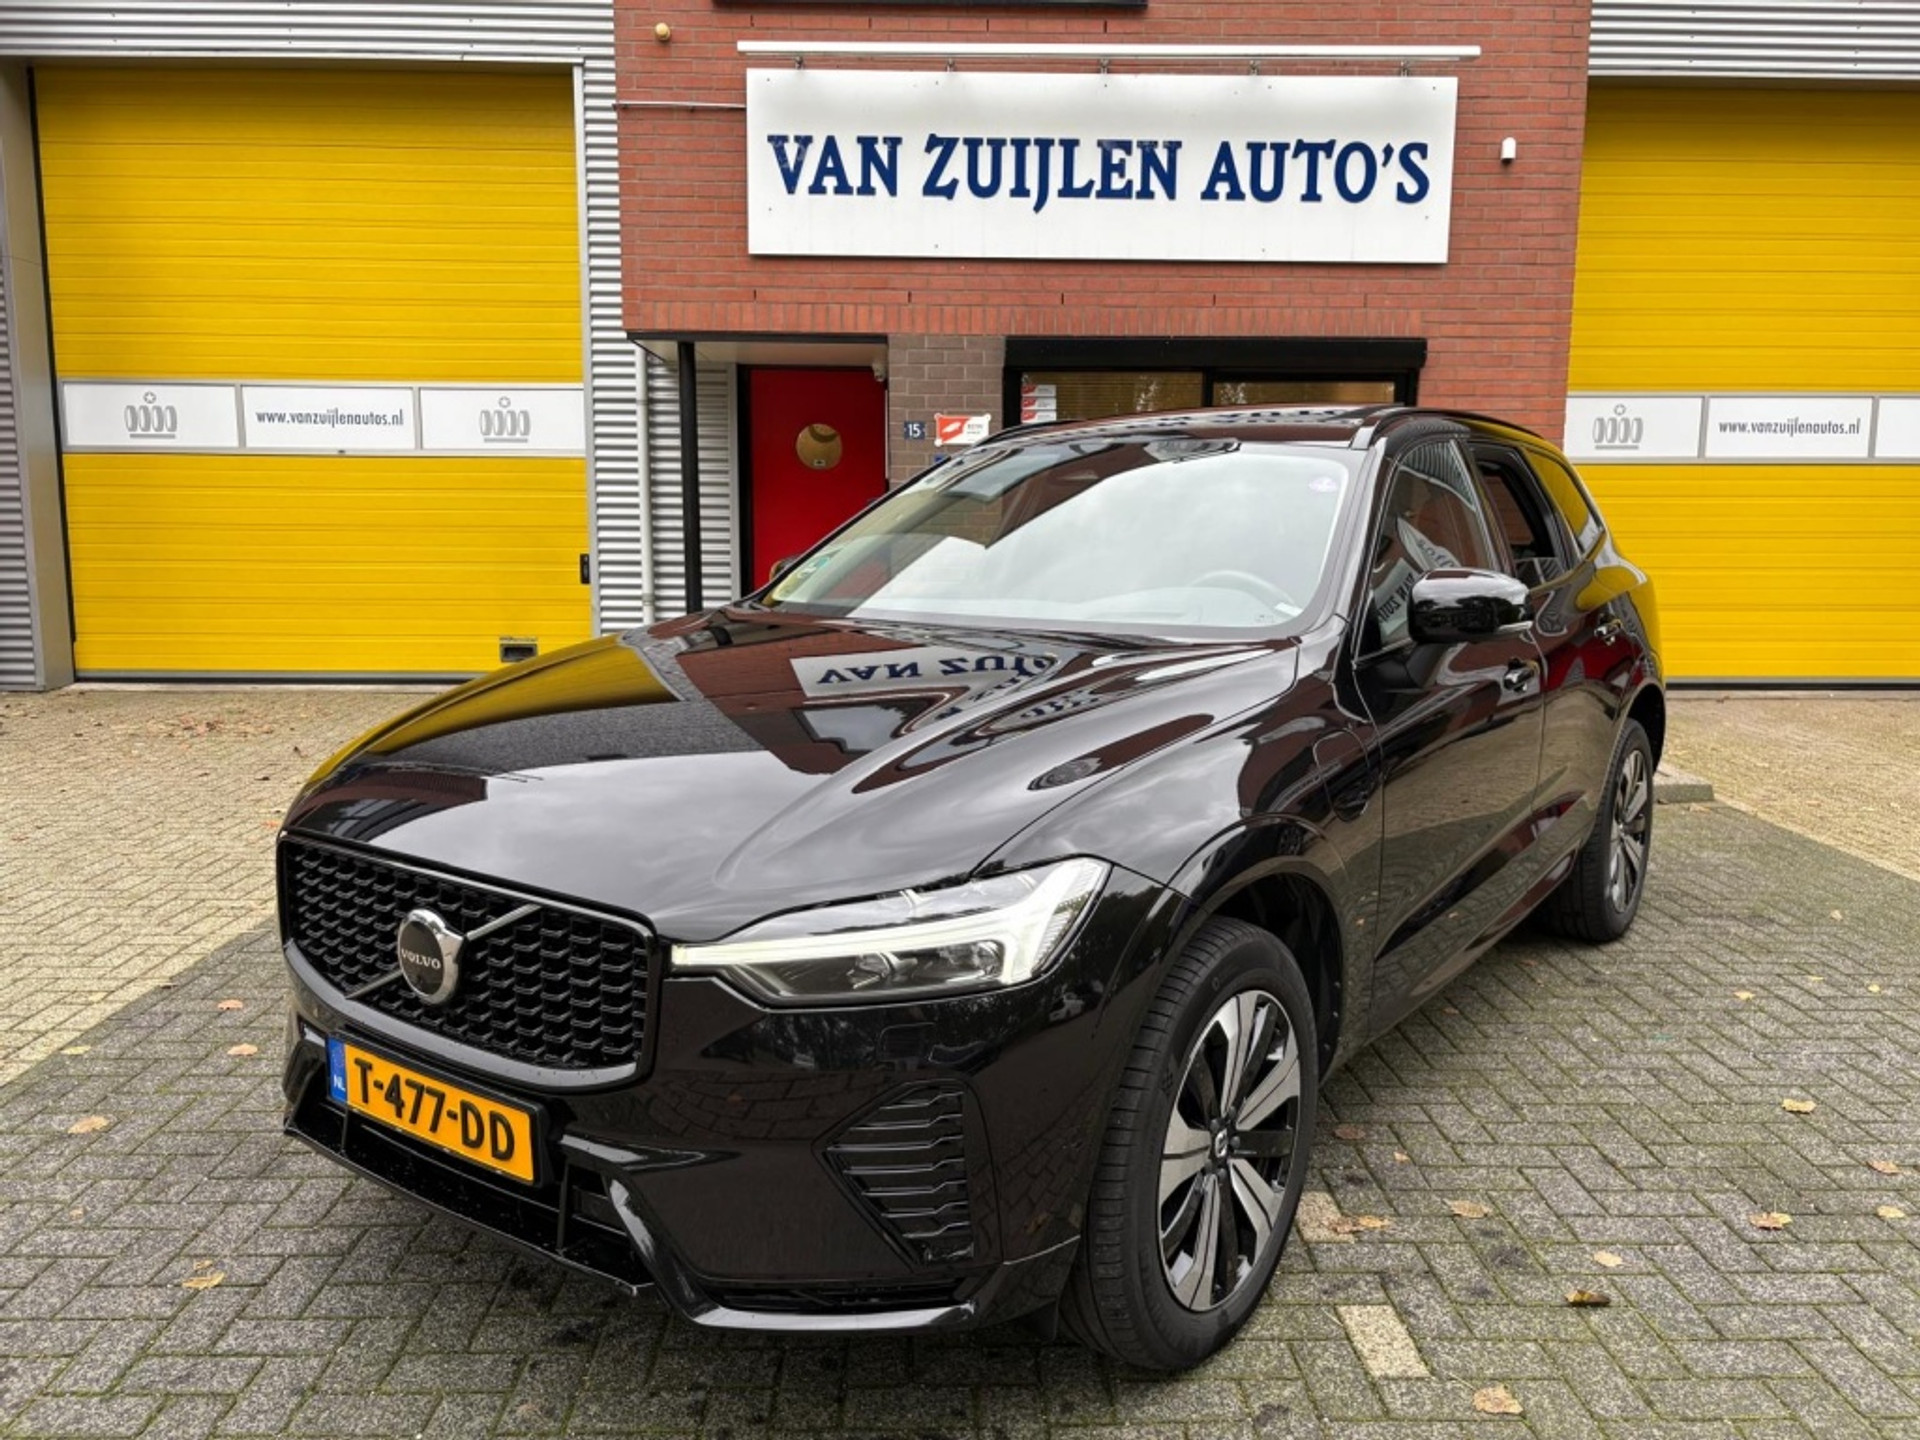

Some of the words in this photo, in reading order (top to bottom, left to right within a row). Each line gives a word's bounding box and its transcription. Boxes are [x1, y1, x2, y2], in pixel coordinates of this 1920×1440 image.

[767, 133, 902, 196] VAN
[923, 133, 1182, 214] ZUIJLEN
[1202, 138, 1430, 204] AUTO'S
[255, 407, 404, 428] www.vanzuijlenautos.nl
[1718, 416, 1861, 437] www.vanzuijlenautos.nl
[908, 423, 921, 437] 15
[401, 948, 442, 970] VOLVO
[333, 1074, 346, 1092] NL
[354, 1057, 515, 1161] T-477-DD
